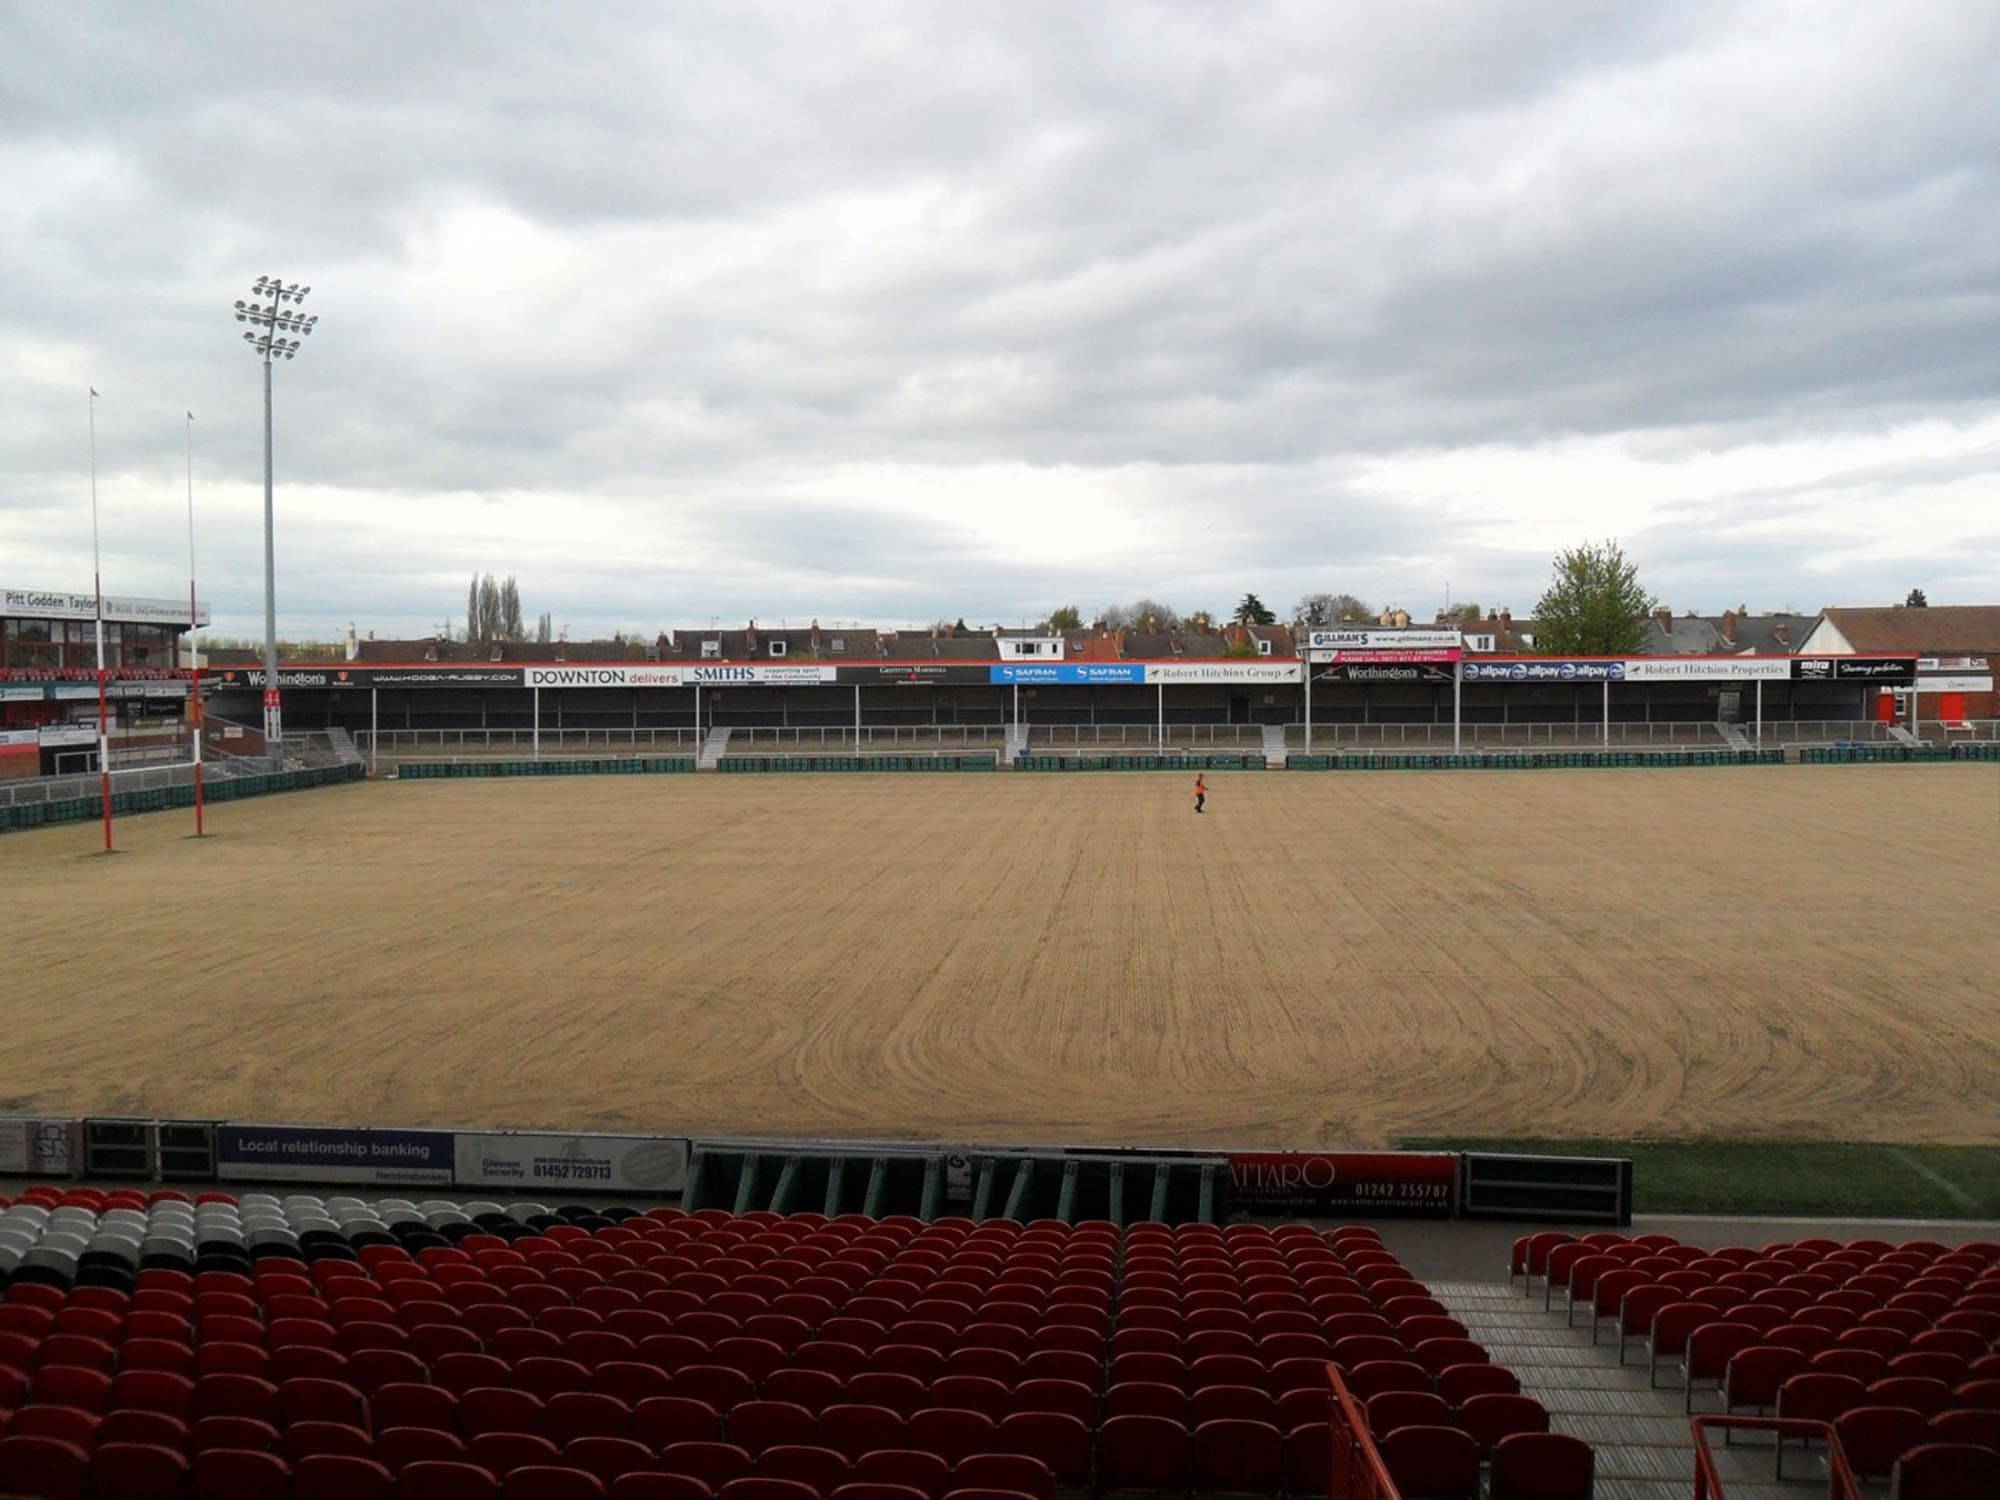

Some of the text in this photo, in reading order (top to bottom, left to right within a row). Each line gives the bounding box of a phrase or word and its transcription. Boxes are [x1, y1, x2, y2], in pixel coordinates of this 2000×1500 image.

[5, 592, 24, 605] Pitt
[27, 594, 64, 608] Godden
[1314, 633, 1368, 646] GILLMAN'S
[532, 670, 678, 684] DOWNTON delivers
[694, 667, 755, 680] SMITHS
[1089, 668, 1131, 676] SAFRAN
[1163, 667, 1281, 680] Robert Hitchins Group
[1347, 666, 1418, 680] Worthington's
[1480, 664, 1608, 677] allpay allpay allpay
[1645, 664, 1784, 676] Robert Hitchins Properties
[247, 671, 326, 687] Wohington's
[238, 1138, 430, 1160] Local relationship banking
[534, 1164, 611, 1180] 01452 729713
[1355, 1183, 1448, 1199] 01242 255787
